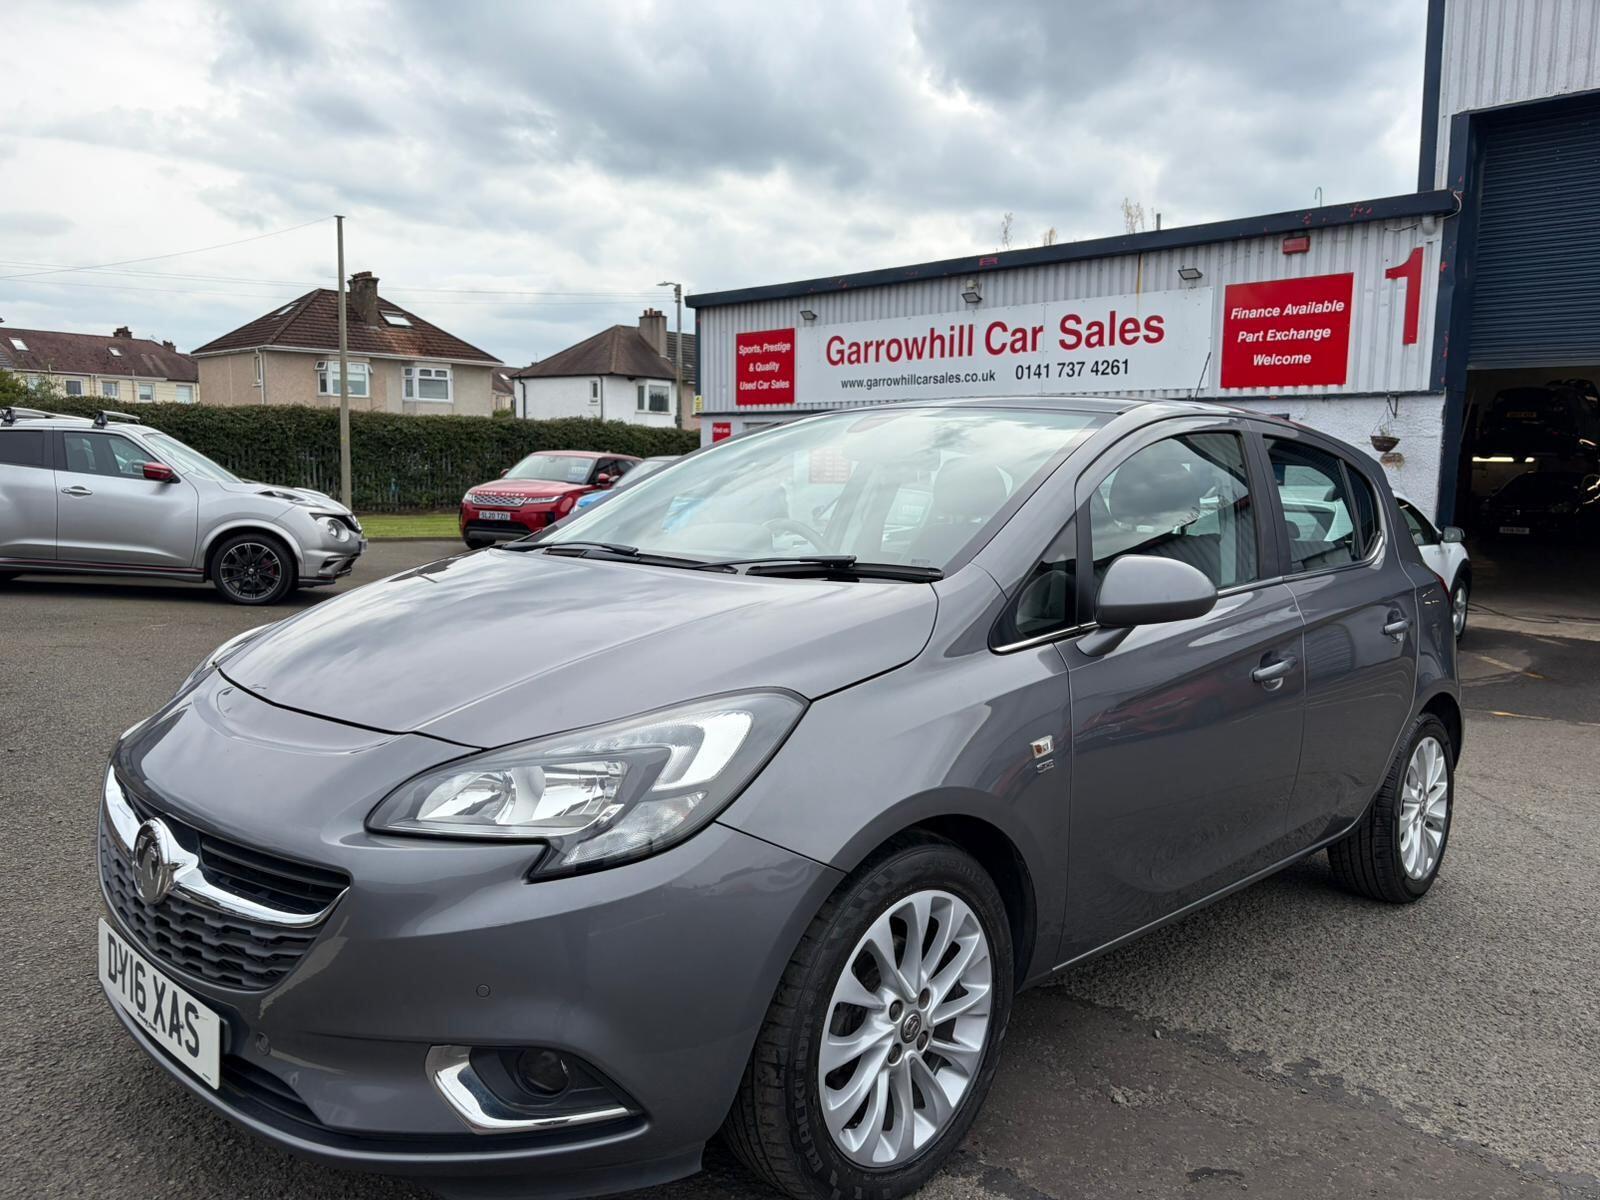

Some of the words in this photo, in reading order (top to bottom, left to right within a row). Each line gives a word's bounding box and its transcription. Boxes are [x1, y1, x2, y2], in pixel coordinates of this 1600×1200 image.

[1385, 247, 1424, 345] 1
[1230, 306, 1281, 320] Finance
[1283, 300, 1345, 316] Available
[826, 324, 974, 366] Garrowhill
[985, 320, 1044, 356] Car
[1059, 310, 1165, 351] Sales
[1237, 331, 1264, 343] Part
[1266, 328, 1331, 342] Exchange
[739, 345, 762, 356] Sports,
[763, 342, 790, 353] Prestige
[749, 363, 754, 372] &
[756, 361, 779, 372] Quality
[1253, 353, 1312, 366] Welcome
[840, 369, 996, 391] www.garrowhillcarsales.co.uk
[1015, 363, 1051, 380] 0141
[1057, 361, 1085, 378] 737
[1090, 358, 1129, 375] 4261
[740, 381, 756, 390] Used
[757, 380, 770, 390] Car
[771, 379, 790, 389] Sales
[107, 932, 147, 1014] DY16
[152, 974, 200, 1060] XAS
